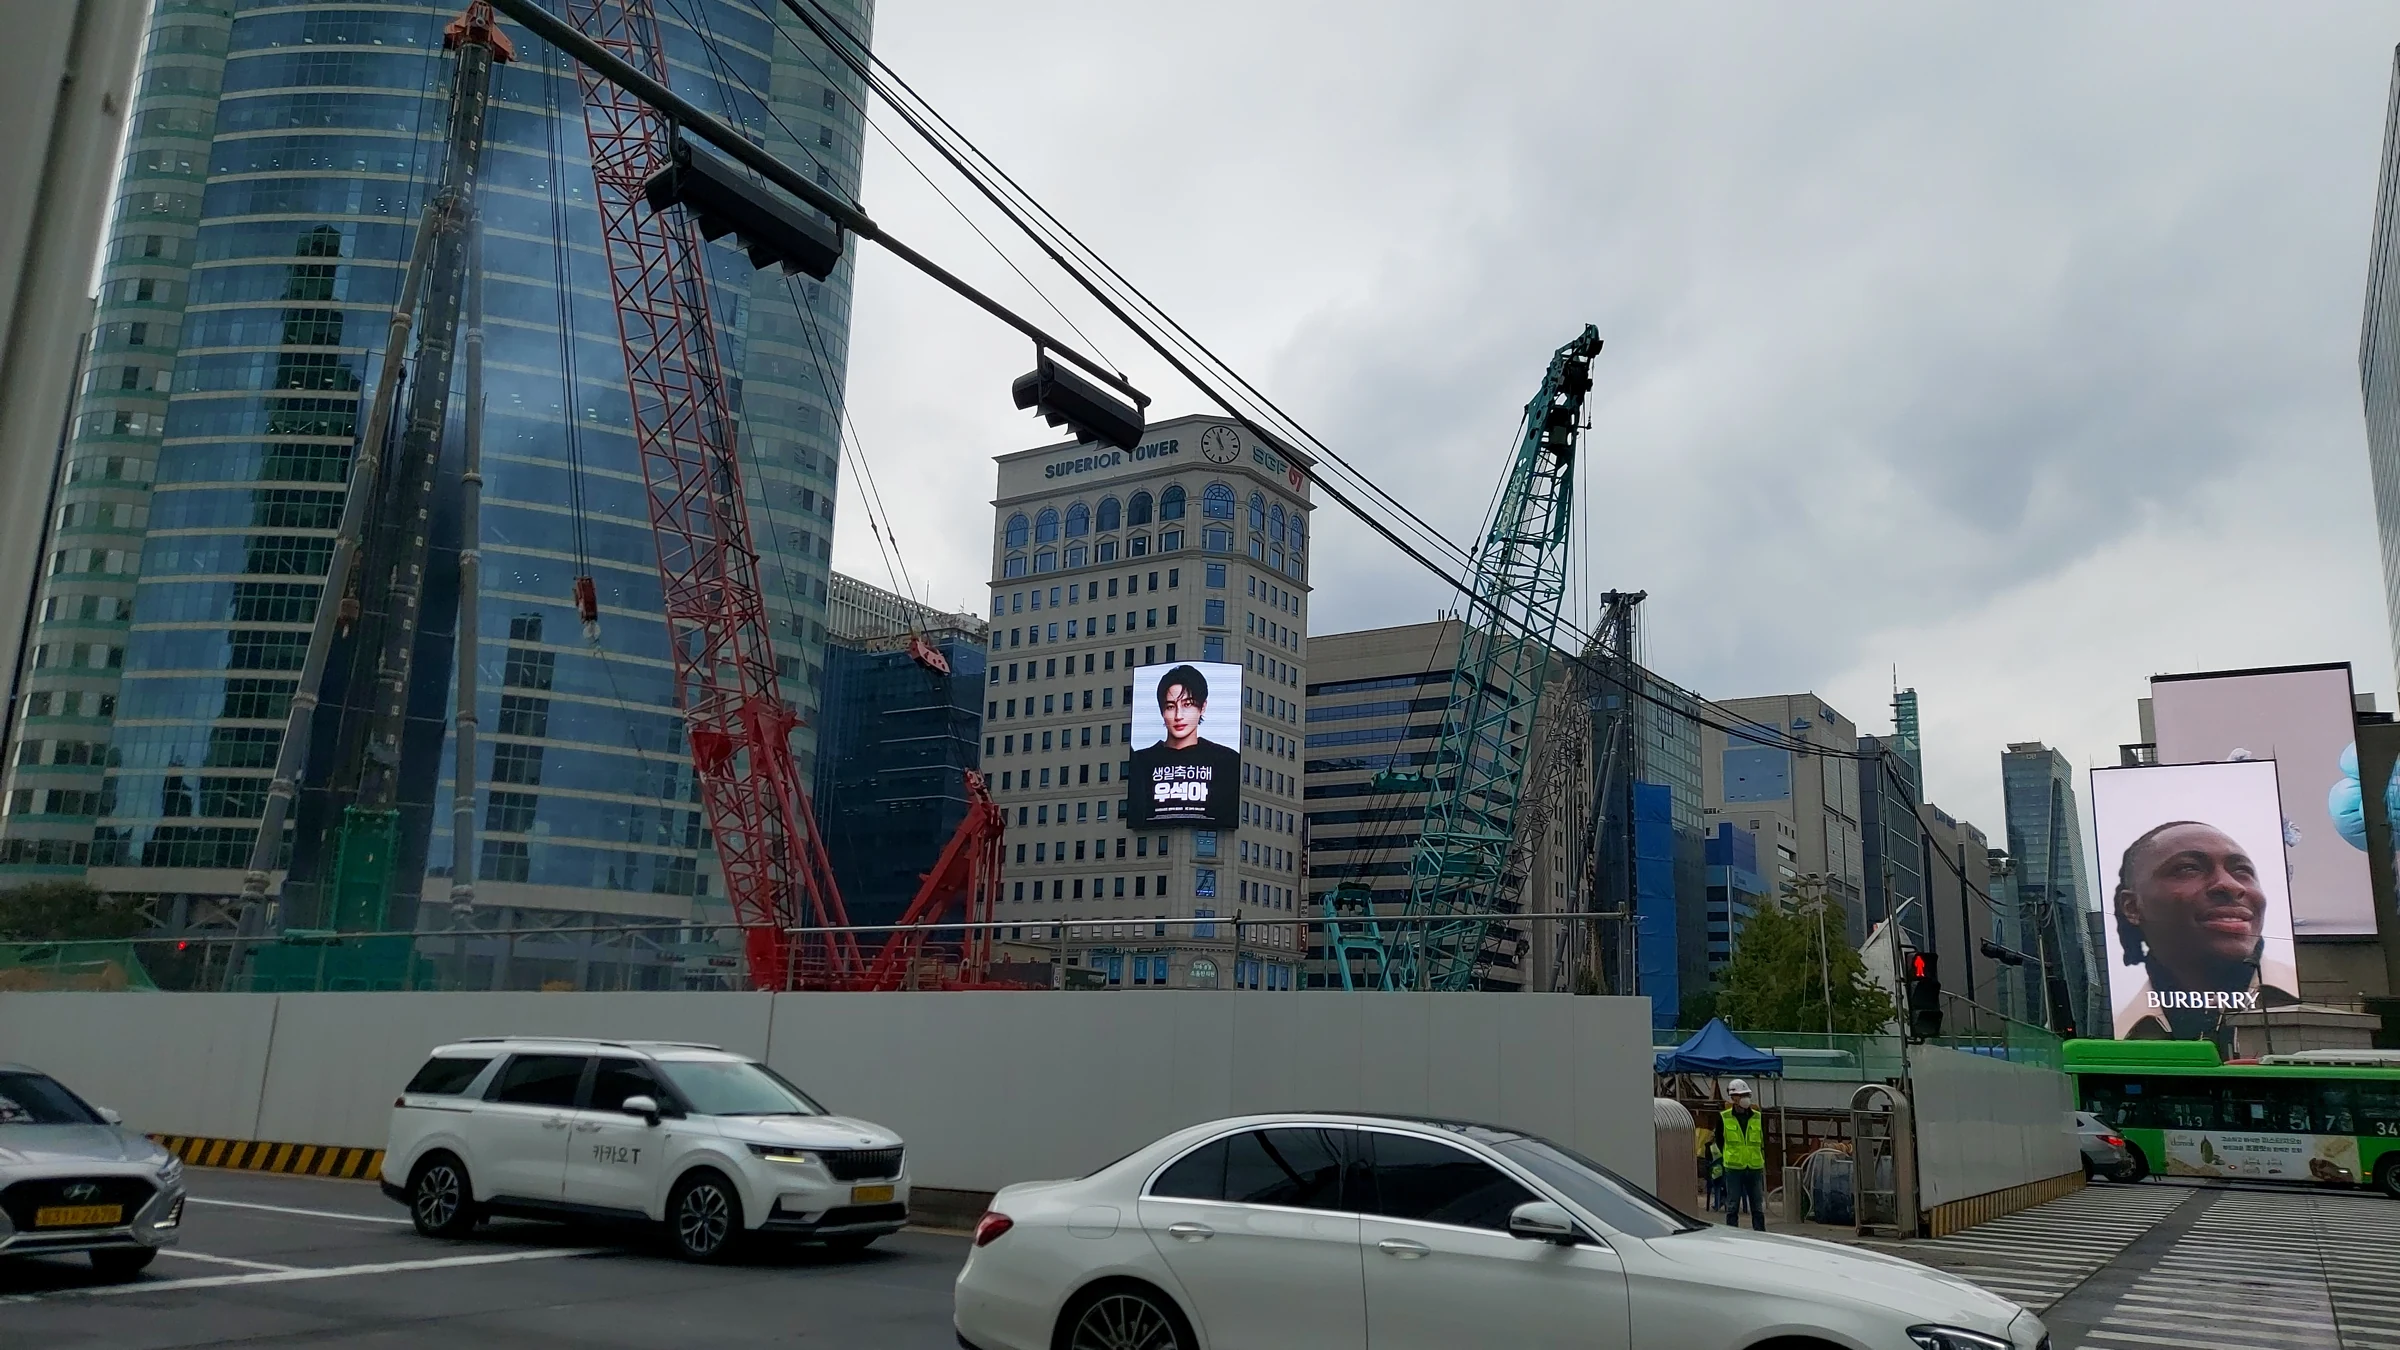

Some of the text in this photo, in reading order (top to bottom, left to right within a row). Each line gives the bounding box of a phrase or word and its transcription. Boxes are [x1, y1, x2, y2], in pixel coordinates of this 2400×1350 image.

[1045, 451, 1120, 479] SUPERIOR
[1152, 765, 1212, 781] 생일축하해
[1154, 782, 1208, 802] 우석아
[2146, 991, 2260, 1009] BURBERRY
[2376, 1121, 2400, 1136] 34
[592, 1144, 641, 1165] 카카오 T
